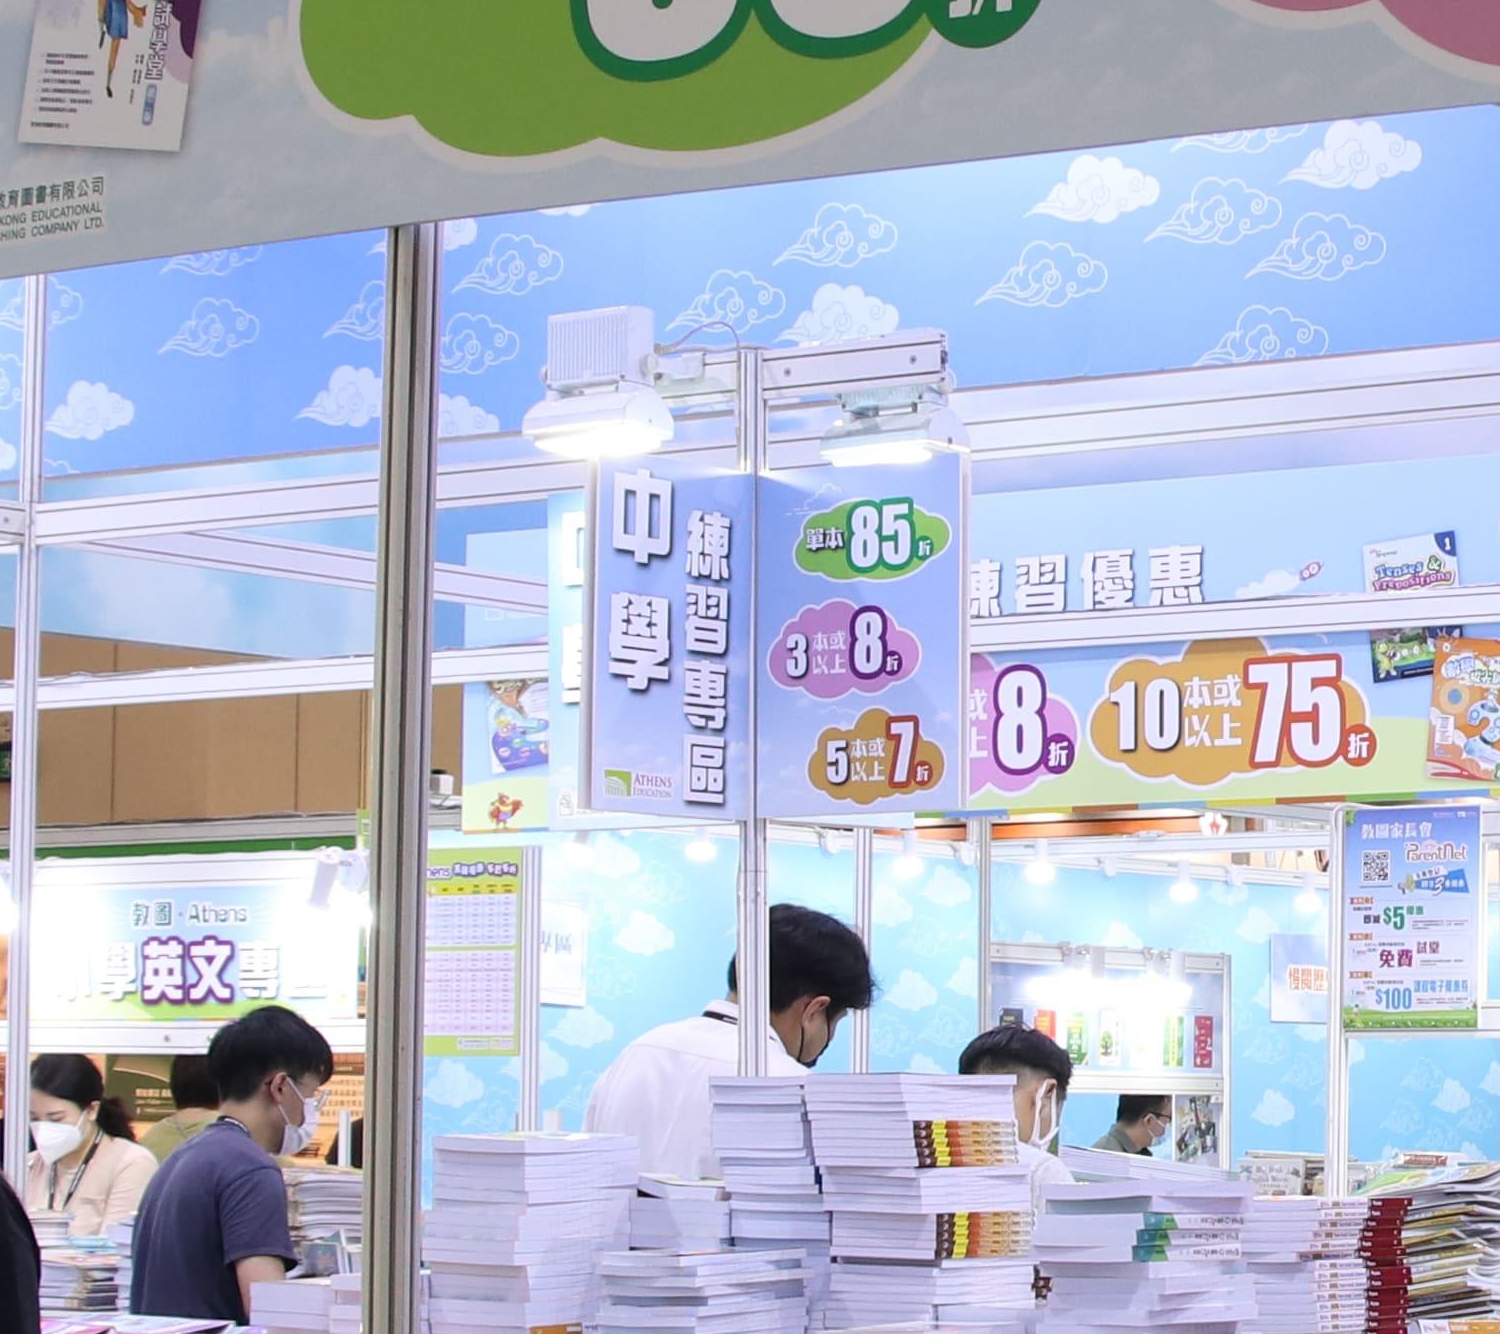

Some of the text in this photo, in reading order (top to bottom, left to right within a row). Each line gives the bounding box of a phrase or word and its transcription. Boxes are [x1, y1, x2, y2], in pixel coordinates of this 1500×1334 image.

[0, 210, 27, 227] KONG
[31, 201, 104, 224] EDUCATIONAL
[30, 220, 83, 239] COMPANY
[849, 502, 912, 569] 85
[609, 468, 674, 691] 中學
[684, 510, 732, 806] 練習專區
[1109, 677, 1181, 752] 10
[1248, 658, 1342, 764] 75
[633, 772, 673, 788] ATHENS
[1375, 986, 1413, 1011] $100
